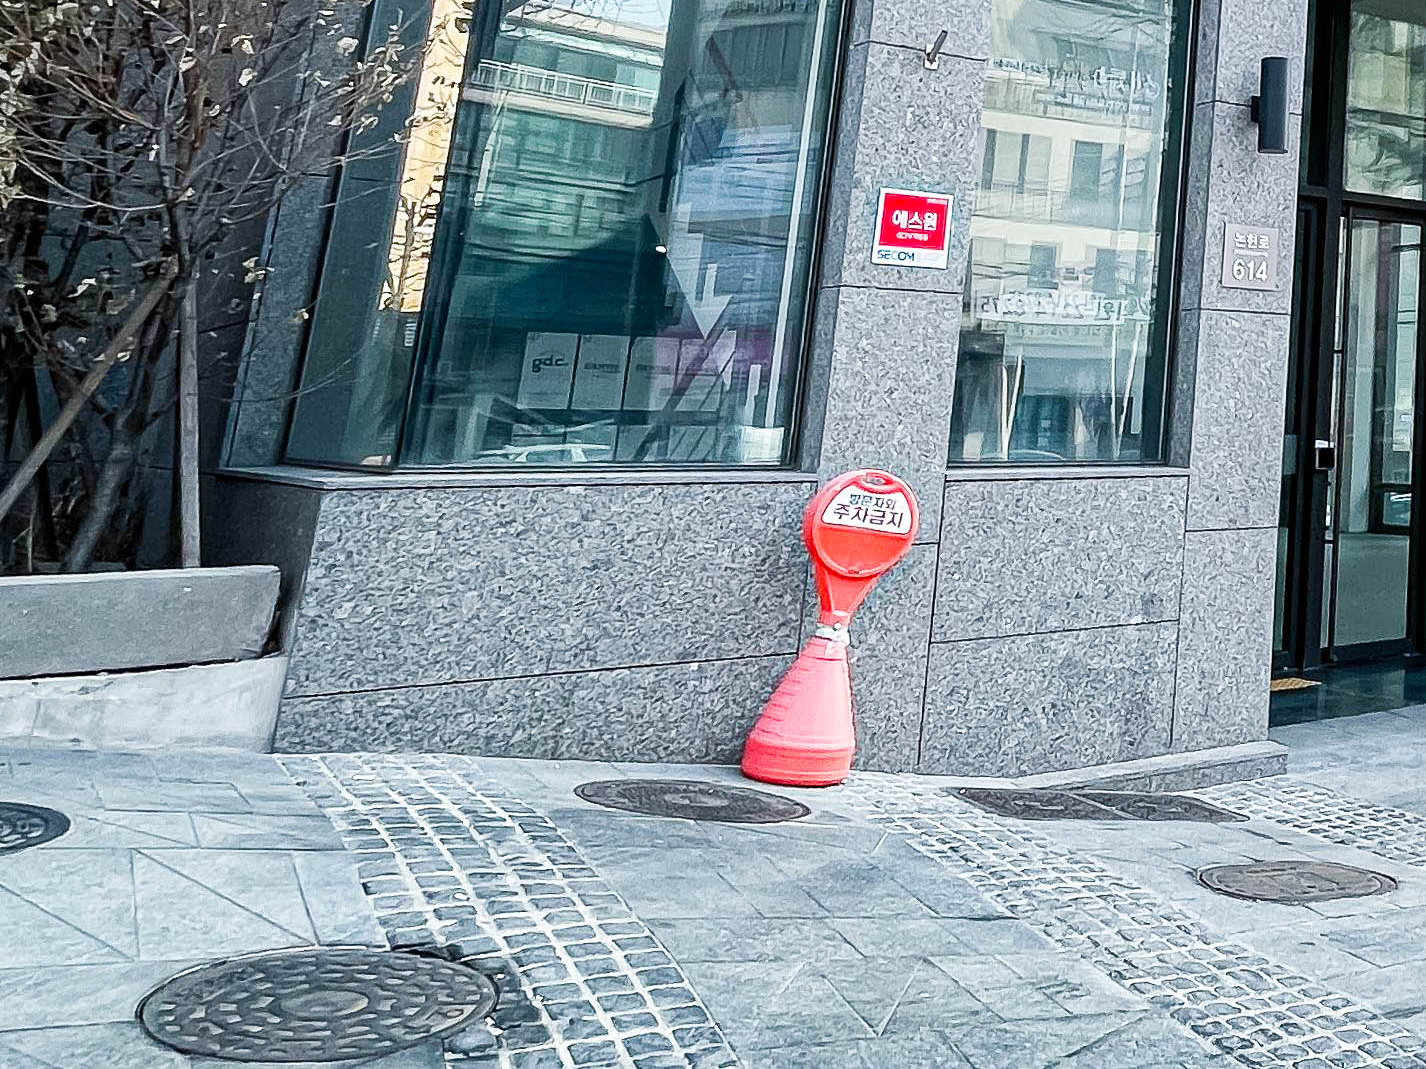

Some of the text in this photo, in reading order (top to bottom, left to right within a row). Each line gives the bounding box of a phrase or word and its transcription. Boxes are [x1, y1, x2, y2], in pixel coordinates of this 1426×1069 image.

[891, 209, 938, 231] 에스원
[1234, 232, 1270, 250] 논현로
[1232, 258, 1269, 282] 614
[849, 493, 897, 511] 방문자외
[833, 503, 904, 529] 주차금지
